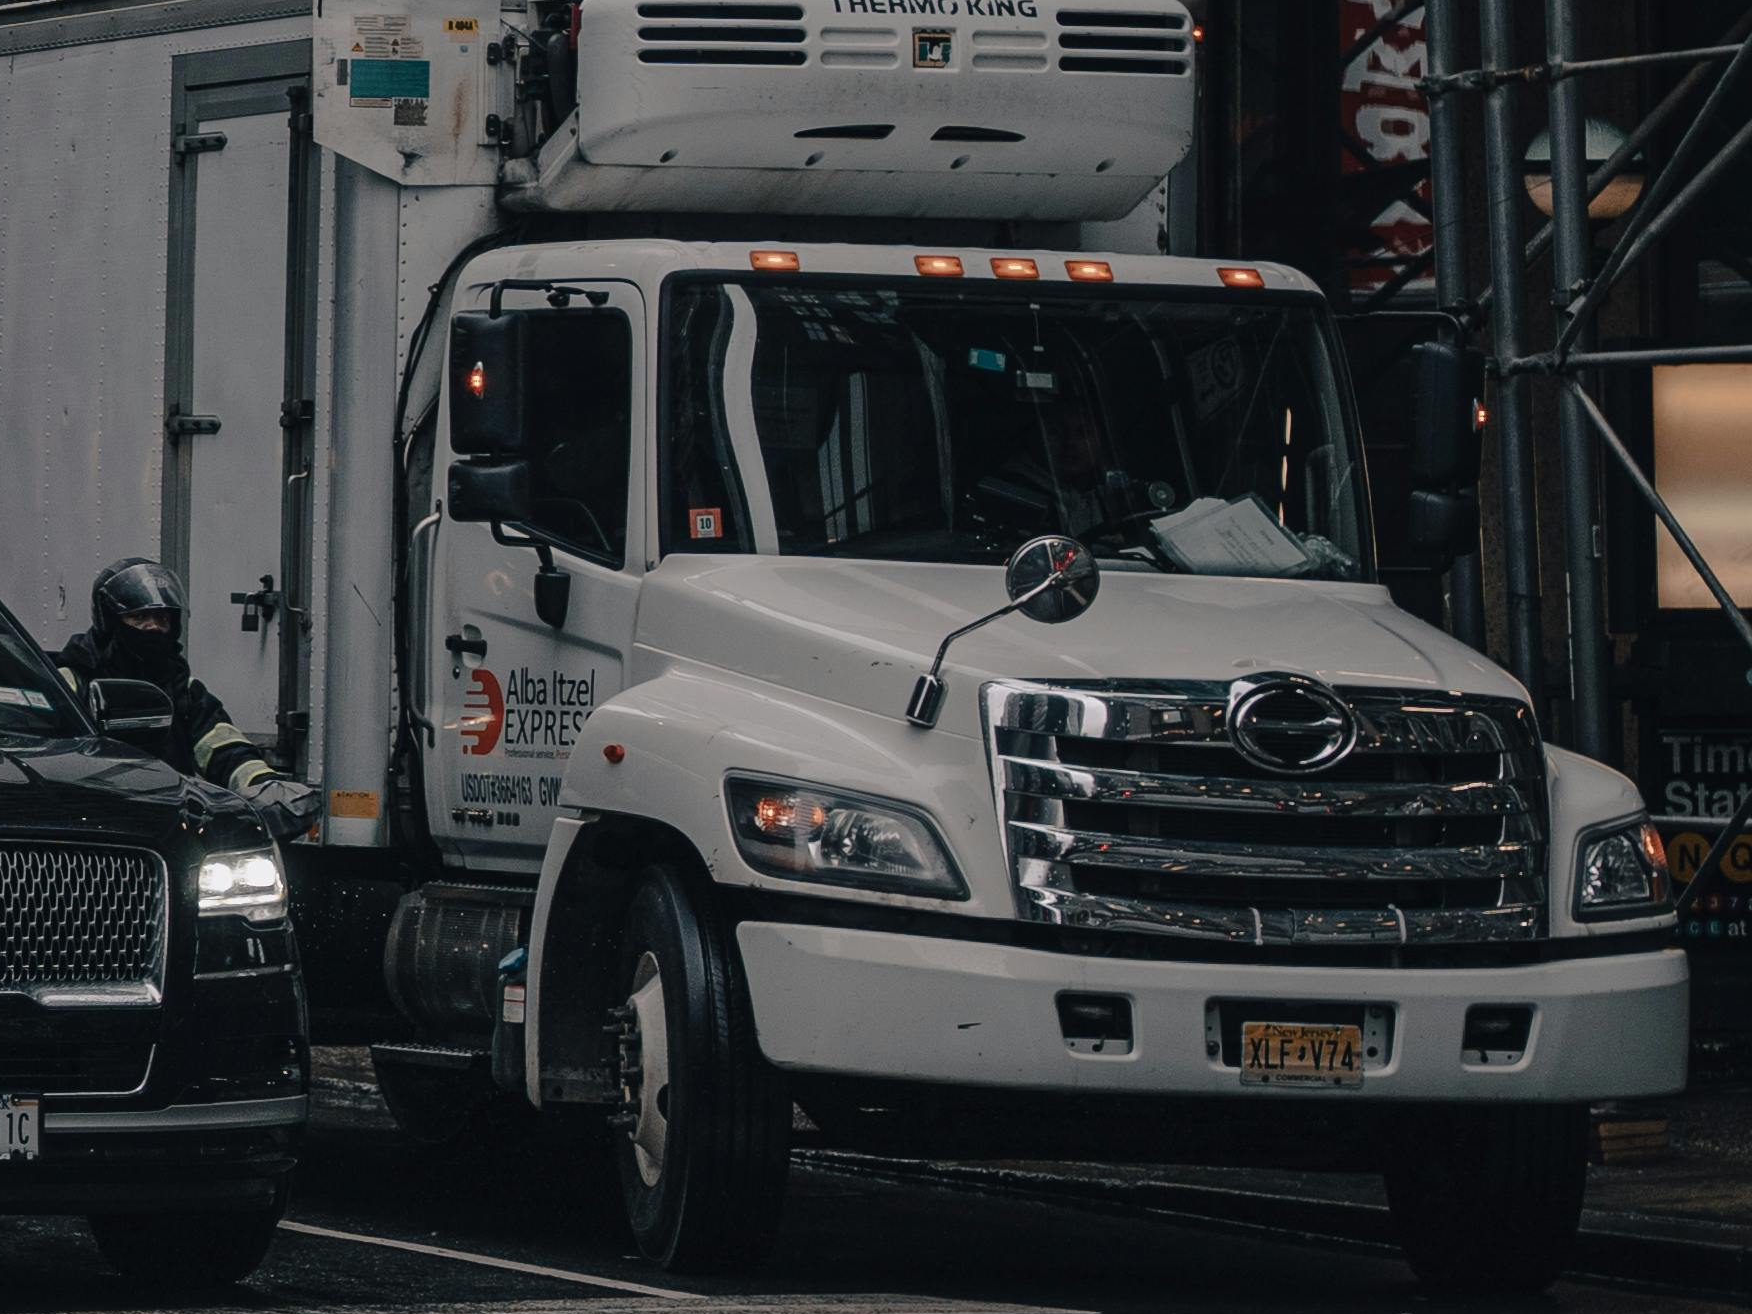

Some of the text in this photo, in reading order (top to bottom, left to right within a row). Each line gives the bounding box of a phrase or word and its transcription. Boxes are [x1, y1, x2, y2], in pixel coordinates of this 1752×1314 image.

[700, 517, 712, 530] 10
[506, 667, 595, 706] Alba Itzel
[504, 709, 593, 746] EXPRES
[1662, 735, 1752, 774] Tim
[1679, 844, 1701, 874] N
[1728, 920, 1747, 936] at
[1250, 1037, 1294, 1070] XLF
